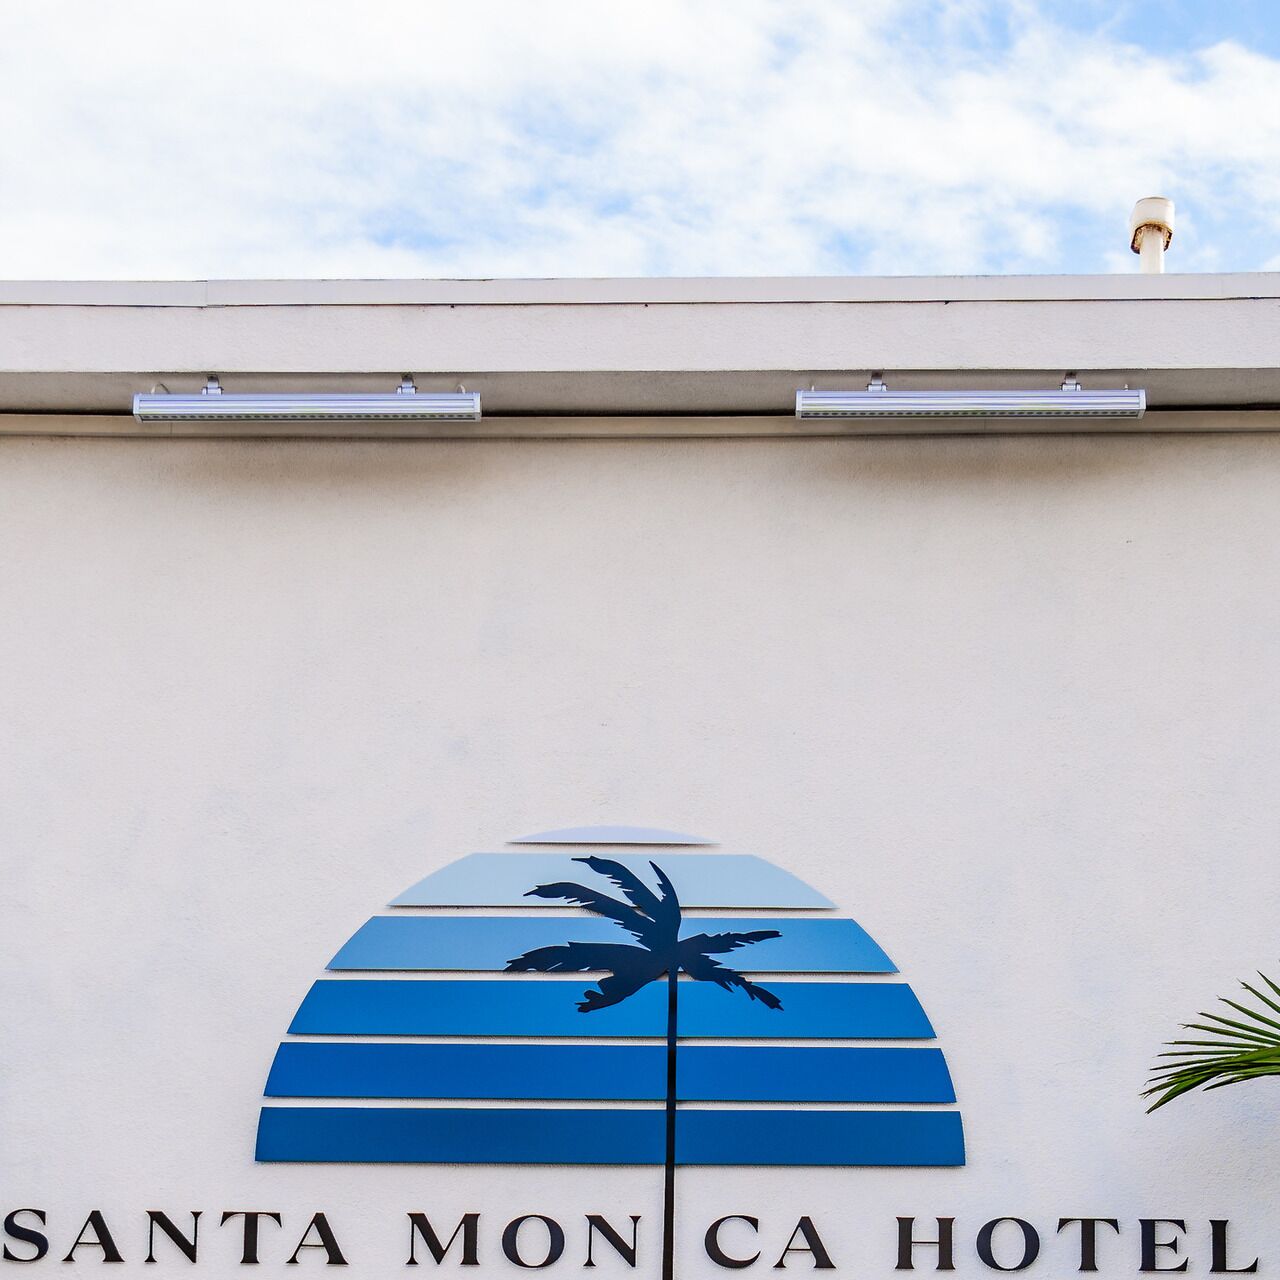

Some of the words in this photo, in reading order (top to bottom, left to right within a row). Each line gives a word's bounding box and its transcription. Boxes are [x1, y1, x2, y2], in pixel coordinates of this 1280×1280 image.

[2, 1207, 349, 1266] SANTA
[406, 1212, 837, 1269] MONICA
[894, 1215, 1259, 1272] HOTEL
